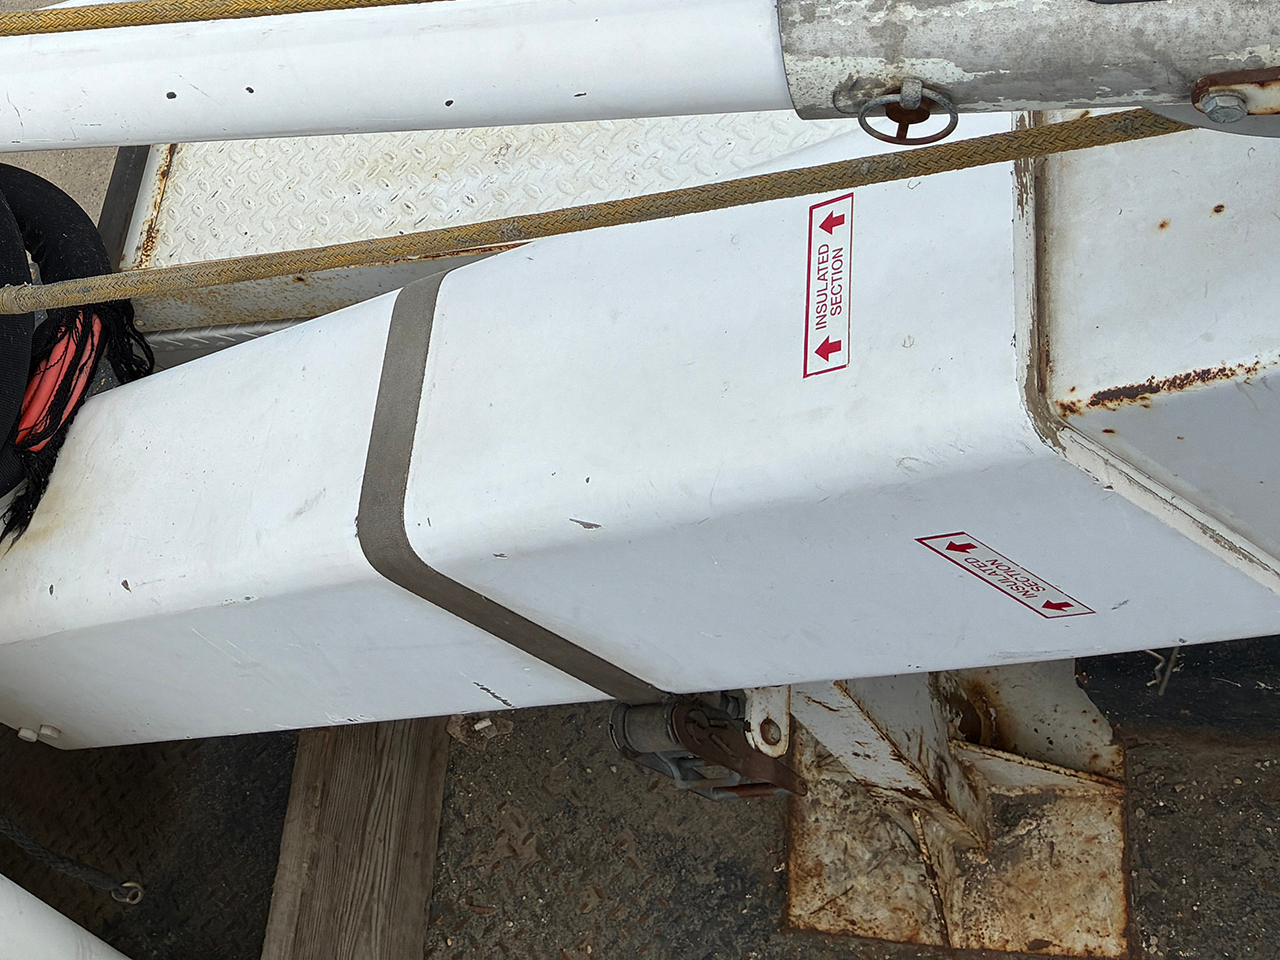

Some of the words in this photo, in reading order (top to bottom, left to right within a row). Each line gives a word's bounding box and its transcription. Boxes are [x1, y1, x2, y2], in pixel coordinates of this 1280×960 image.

[816, 244, 829, 330] INSULATED
[830, 247, 844, 316] SECTION
[964, 557, 1038, 599] INSULATED
[986, 558, 1046, 593] SECTION
